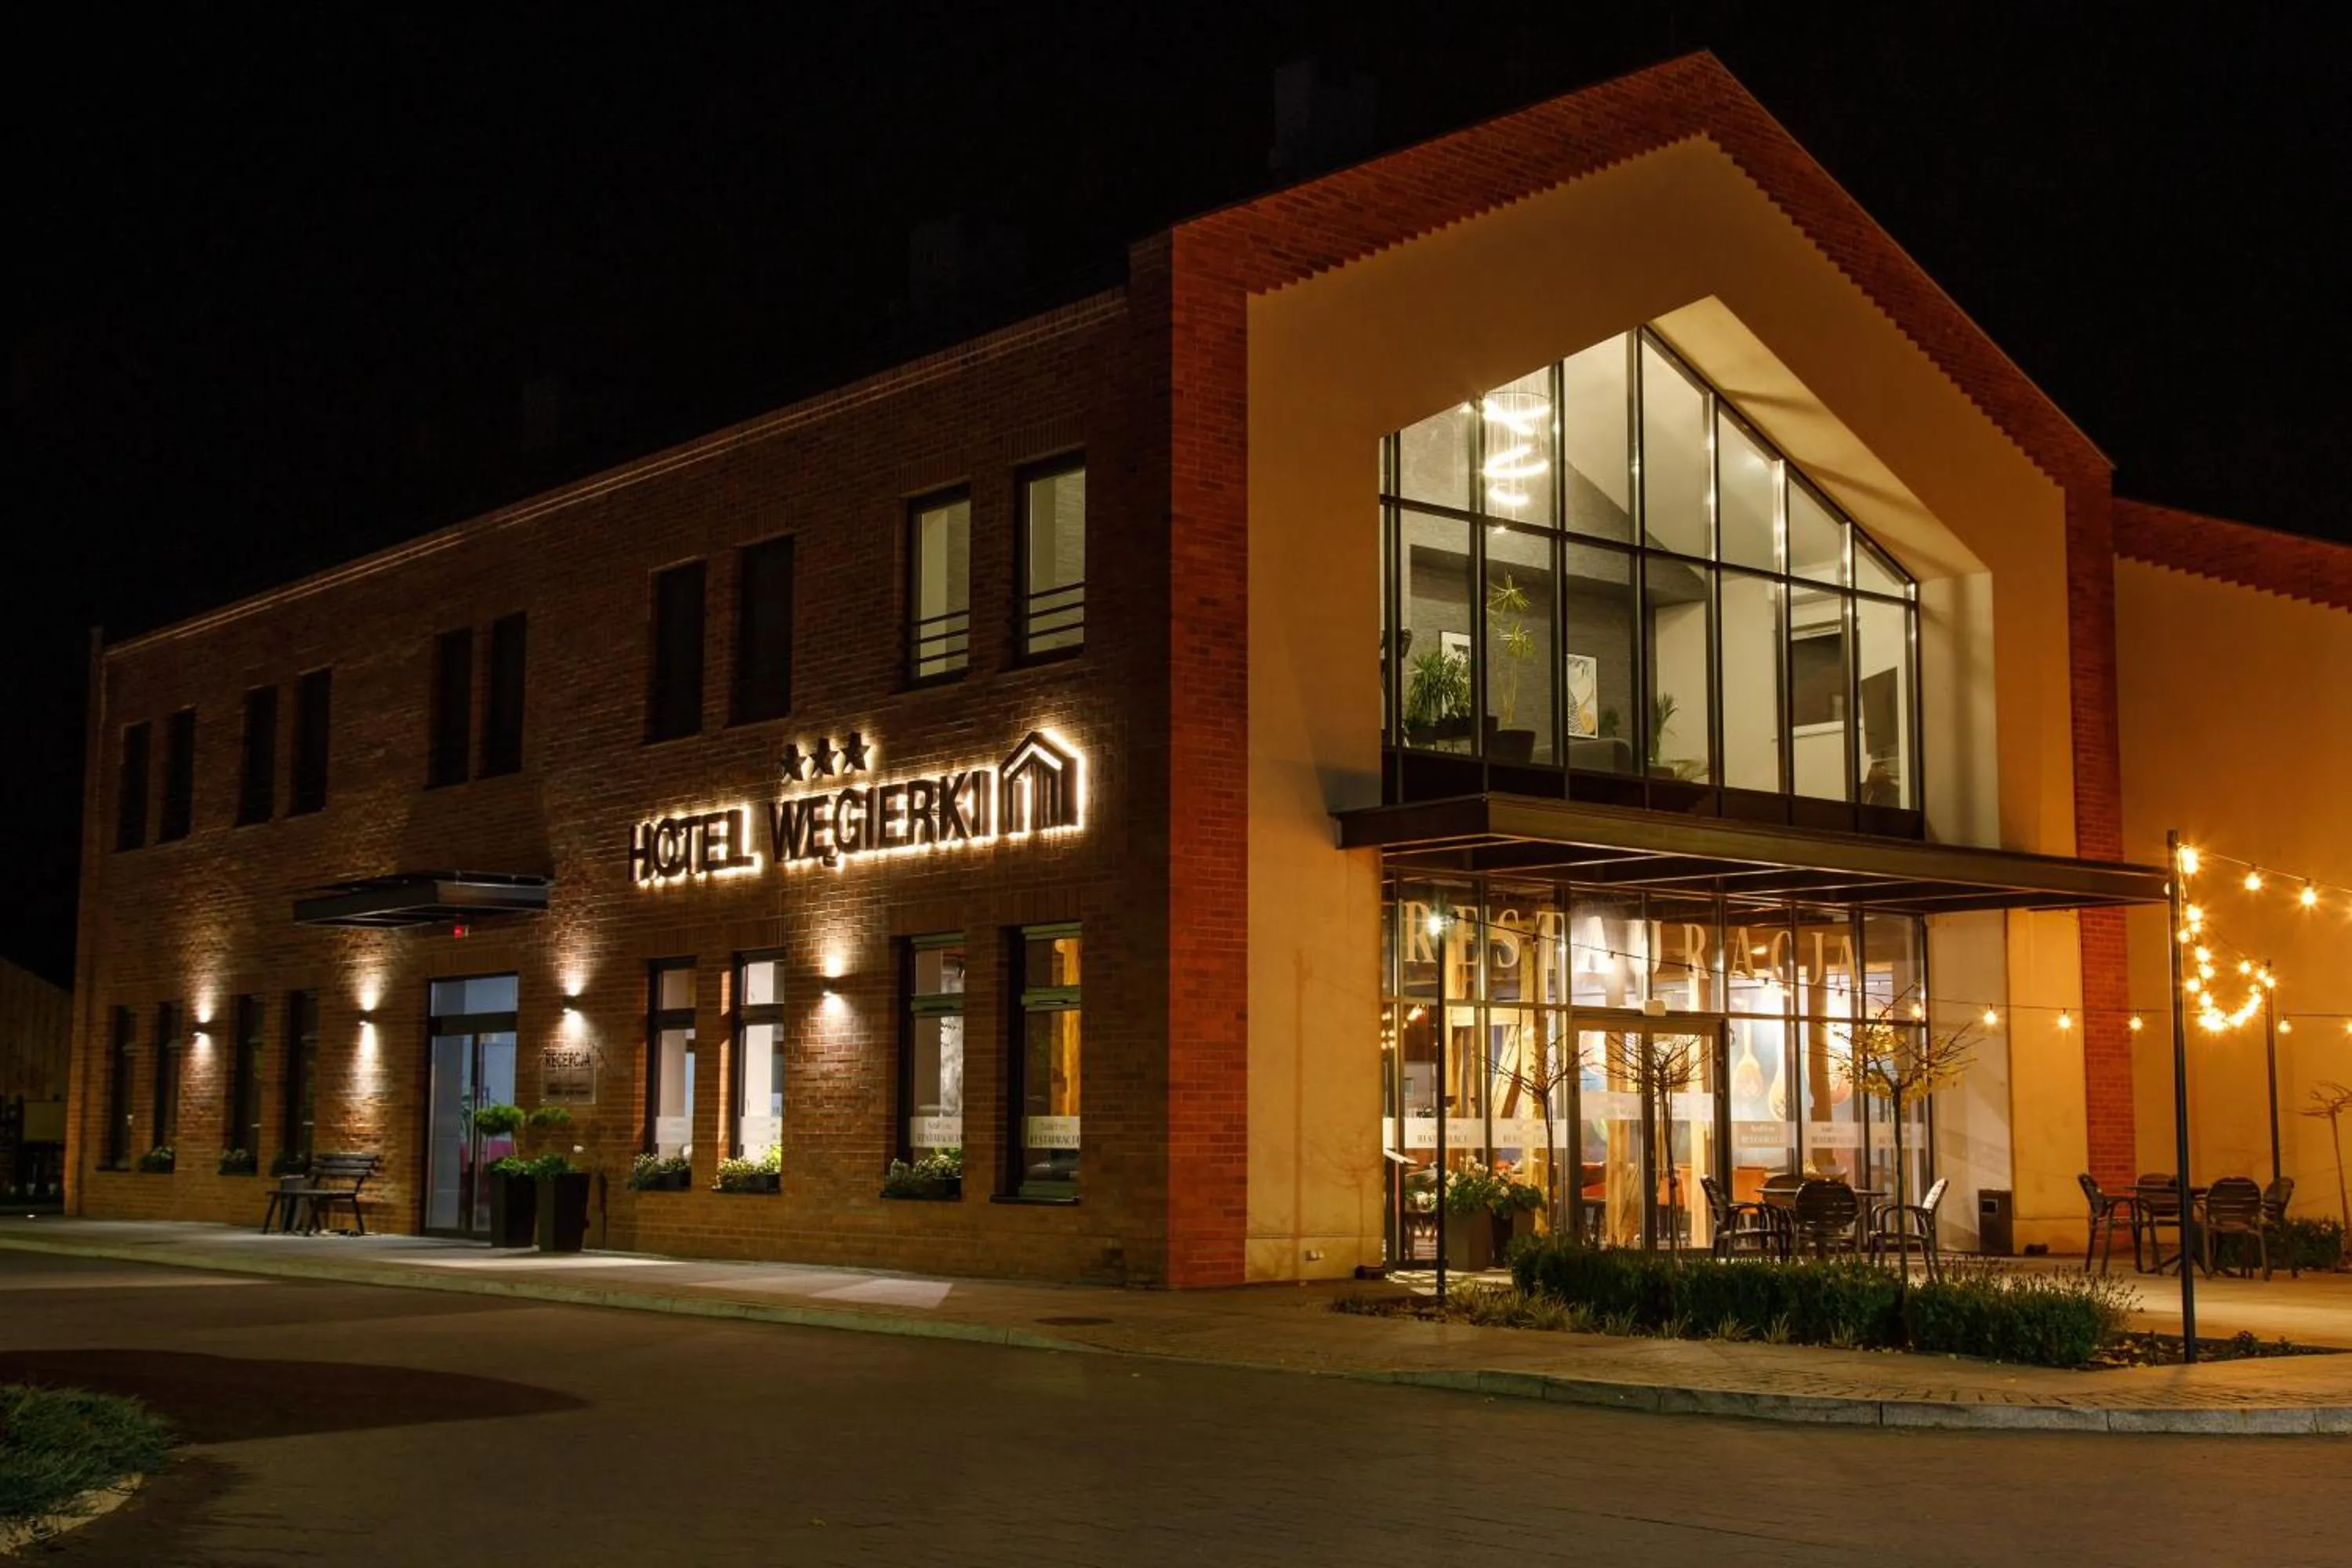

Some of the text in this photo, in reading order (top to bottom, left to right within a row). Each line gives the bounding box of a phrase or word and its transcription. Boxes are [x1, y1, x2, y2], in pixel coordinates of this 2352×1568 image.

[629, 769, 984, 881] HOTEL WĘGIERKI
[1401, 901, 1862, 991] RESTAURACJA
[544, 1051, 591, 1068] RECEPCJA
